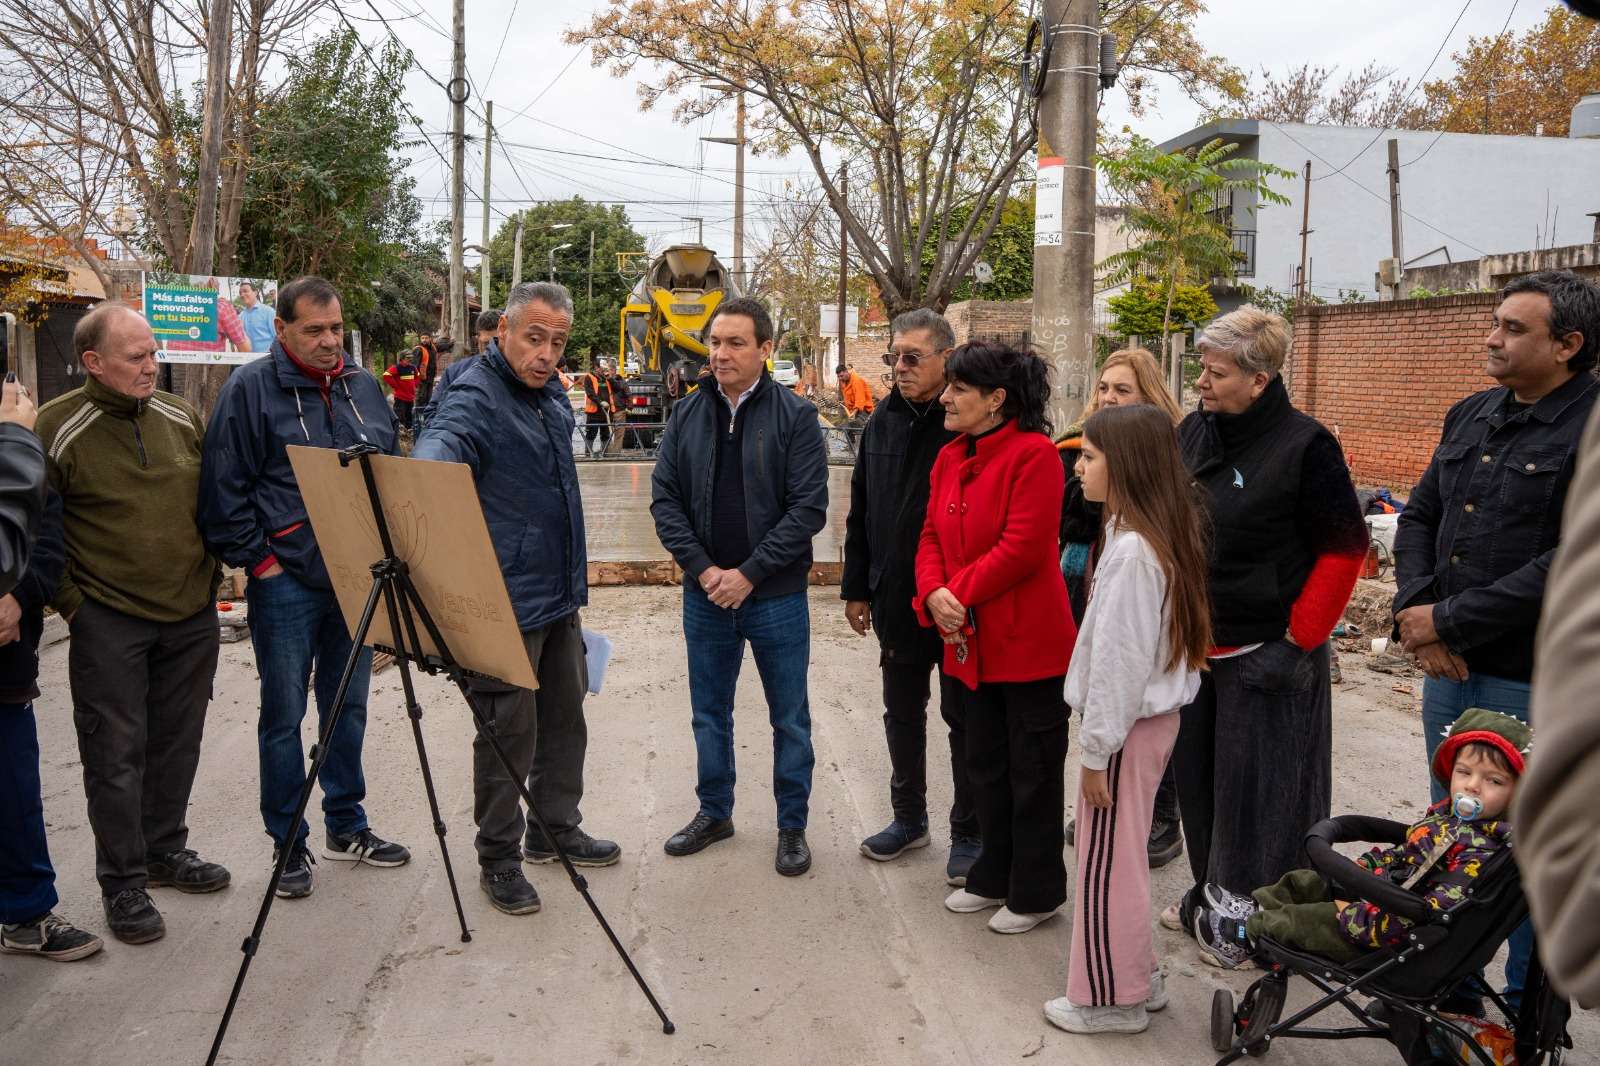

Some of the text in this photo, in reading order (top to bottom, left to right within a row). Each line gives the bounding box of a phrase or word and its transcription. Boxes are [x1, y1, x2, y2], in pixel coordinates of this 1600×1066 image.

[152, 292, 213, 304] Más asfaltos
[152, 304, 205, 314] renovados
[167, 314, 178, 322] tu
[180, 315, 210, 323] barrio
